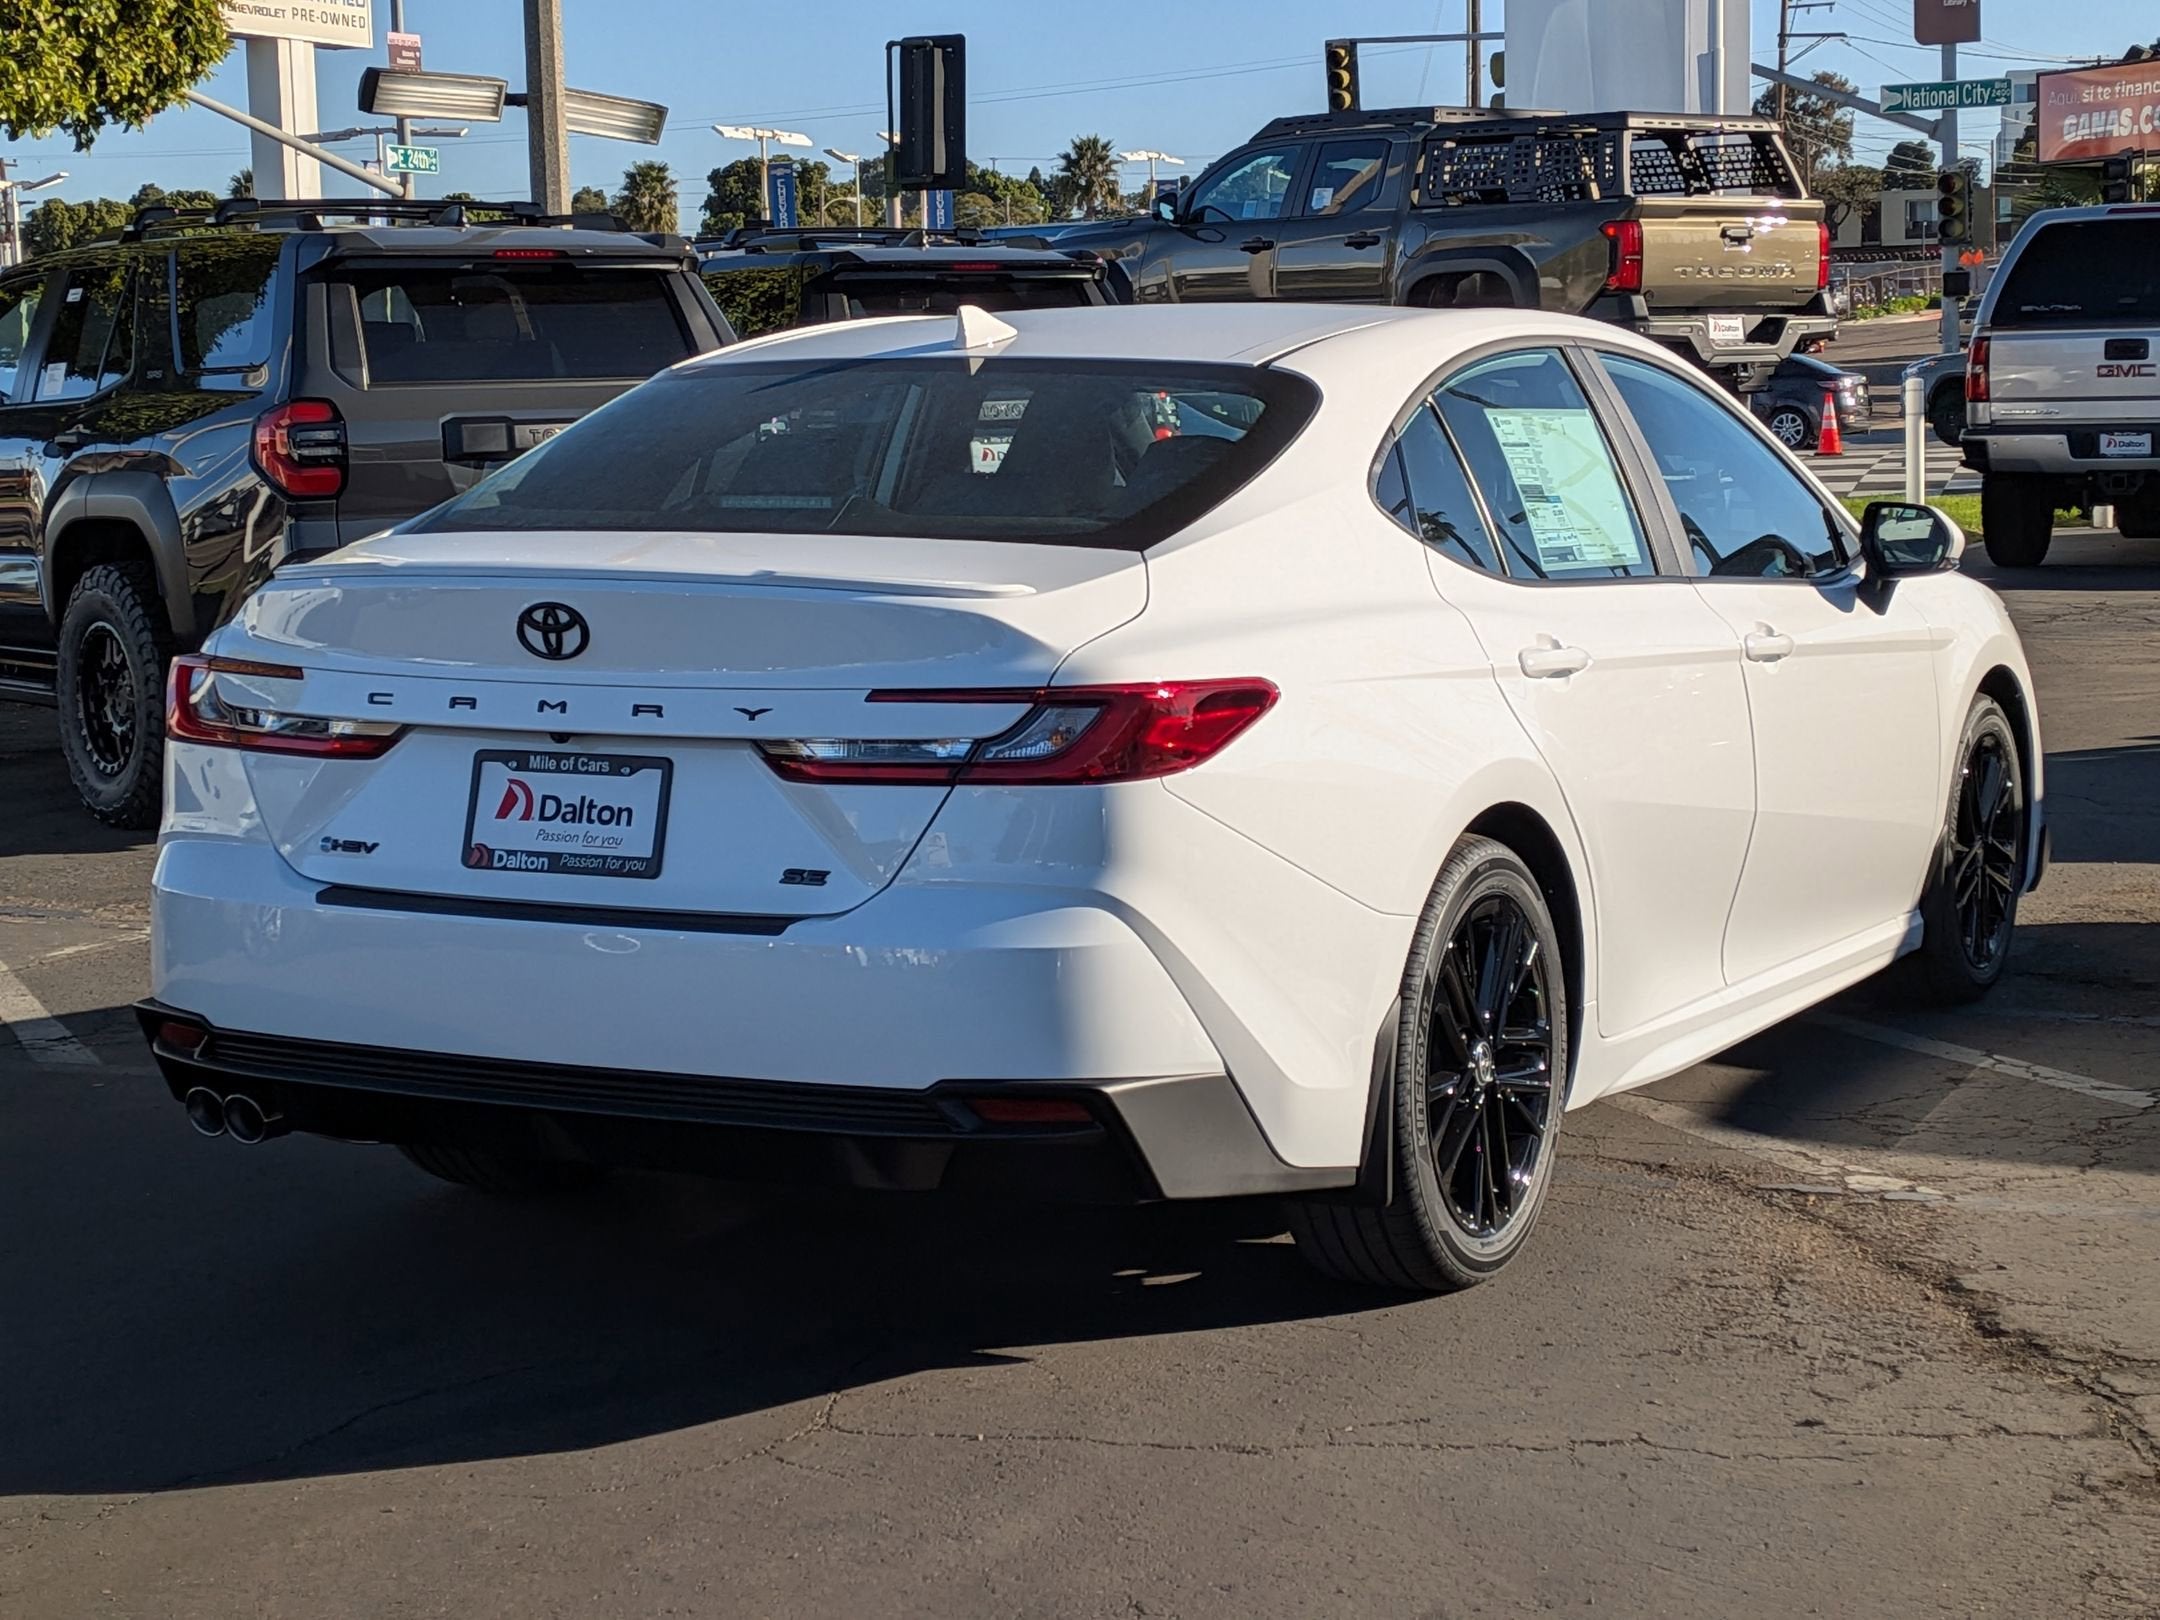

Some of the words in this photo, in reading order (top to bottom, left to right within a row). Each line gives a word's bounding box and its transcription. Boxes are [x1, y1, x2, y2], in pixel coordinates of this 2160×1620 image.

[291, 7, 366, 29] PRE-OWNED
[1902, 85, 1959, 109] National
[1963, 83, 1991, 105] City
[2098, 86, 2111, 101] te
[398, 149, 407, 168] E
[408, 150, 429, 169] 24th
[1674, 265, 1797, 279] TACOMA
[2096, 363, 2157, 378] GMC
[2118, 440, 2146, 448] Dalton
[367, 692, 773, 722] CAMRY
[529, 755, 556, 770] Mile
[560, 758, 574, 771] of
[578, 759, 610, 773] Cars
[538, 794, 633, 827] Dalton
[536, 828, 579, 844] Passion
[582, 831, 599, 846] for
[601, 836, 623, 847] you
[493, 850, 549, 870] Dalton
[560, 854, 603, 868] Passion
[605, 857, 623, 870] for
[623, 860, 647, 872] you
[779, 868, 832, 886] SE
[1415, 1027, 1427, 1147] KINERGY
